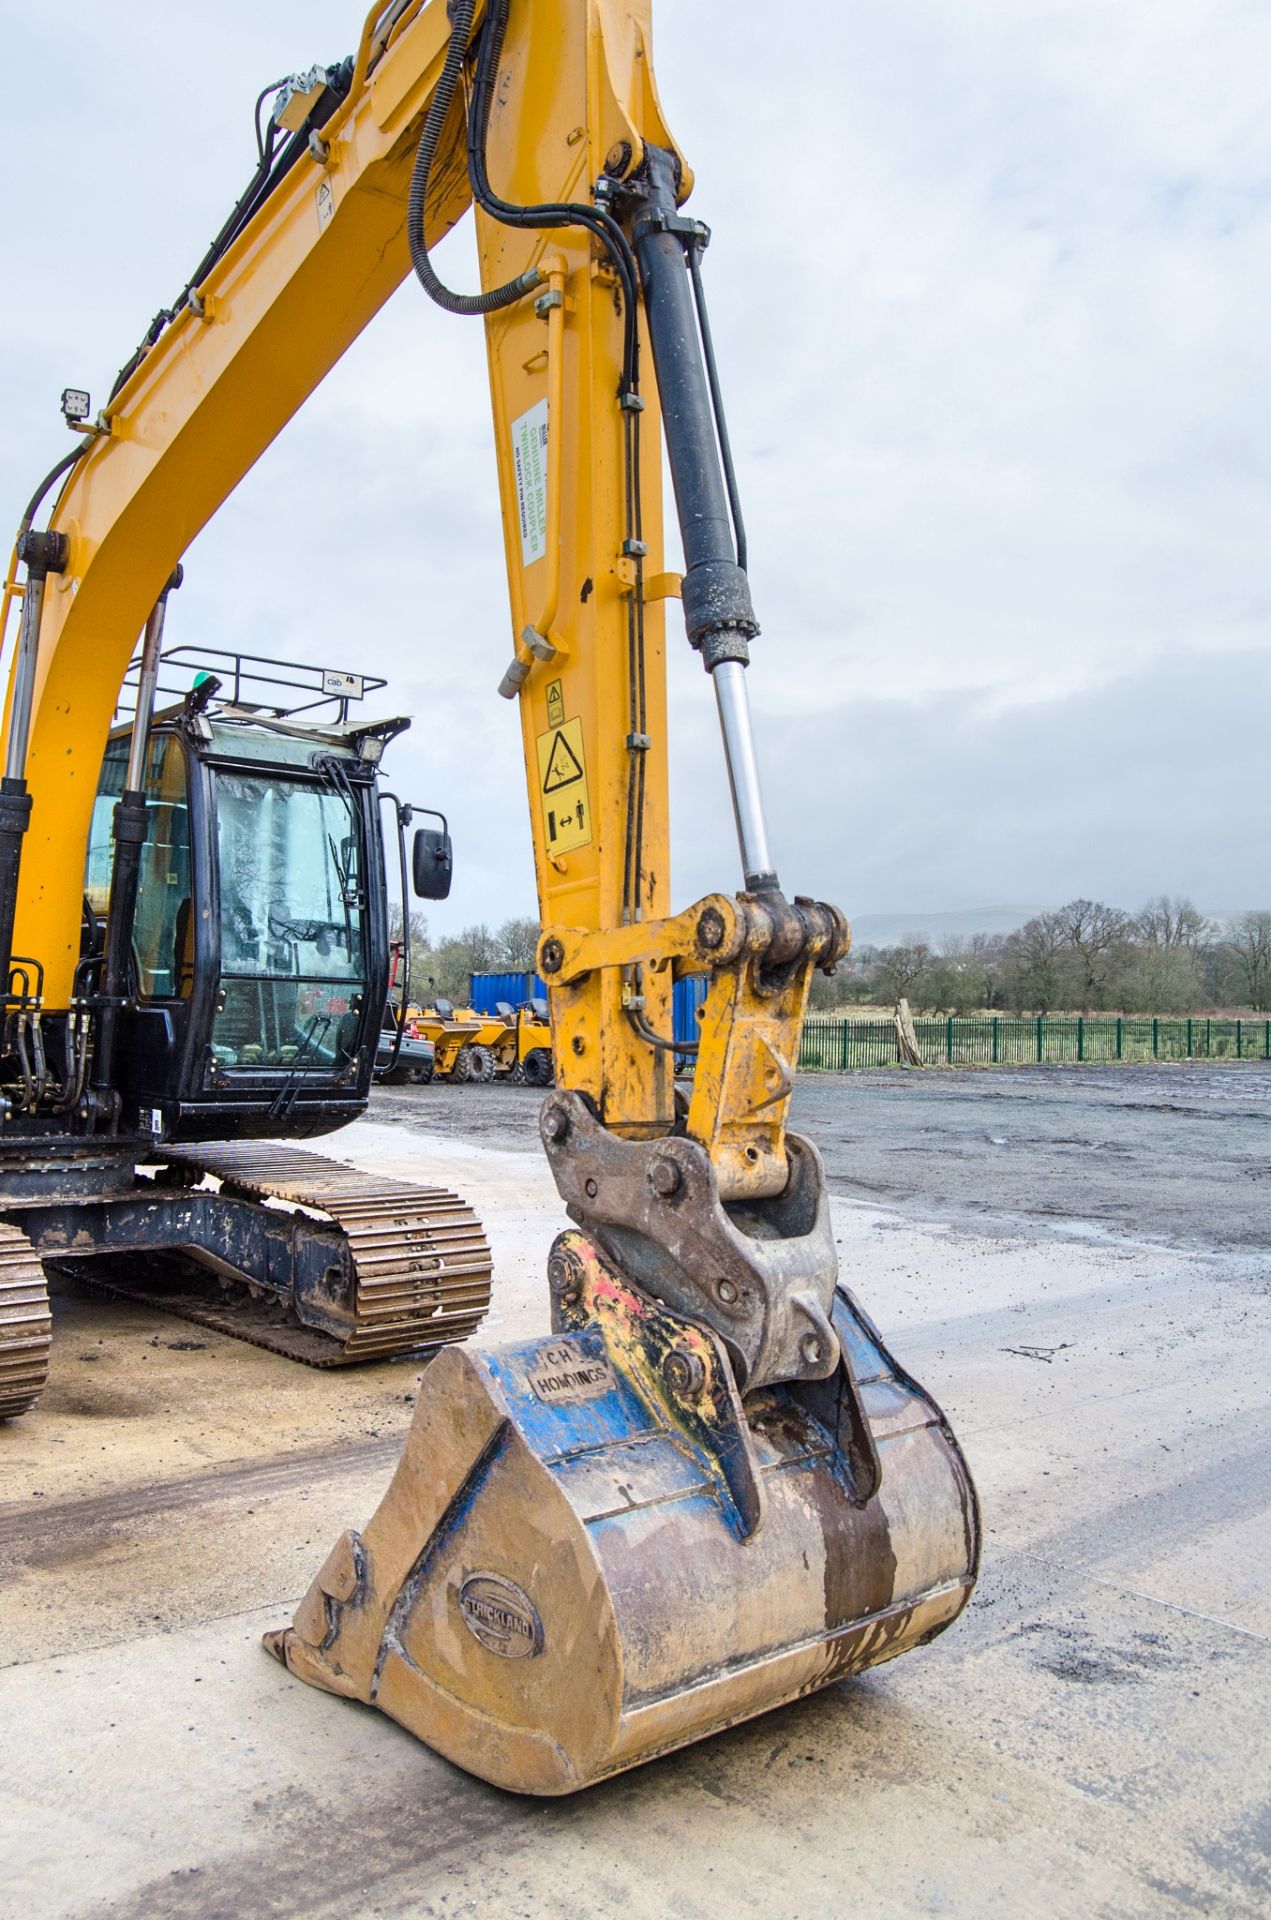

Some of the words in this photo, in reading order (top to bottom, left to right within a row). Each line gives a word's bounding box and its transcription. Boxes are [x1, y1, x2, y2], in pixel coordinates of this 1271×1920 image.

[520, 421, 534, 489] TWINLOCK
[529, 427, 542, 486] GENUINE
[515, 447, 520, 458] NO
[520, 501, 528, 539] REQUIRED
[535, 487, 546, 537] MILLER
[526, 492, 539, 553] COUPLER
[327, 678, 342, 687] cab
[537, 1367, 607, 1393] HOLDINGS
[464, 1597, 530, 1637] STRICKLAND
